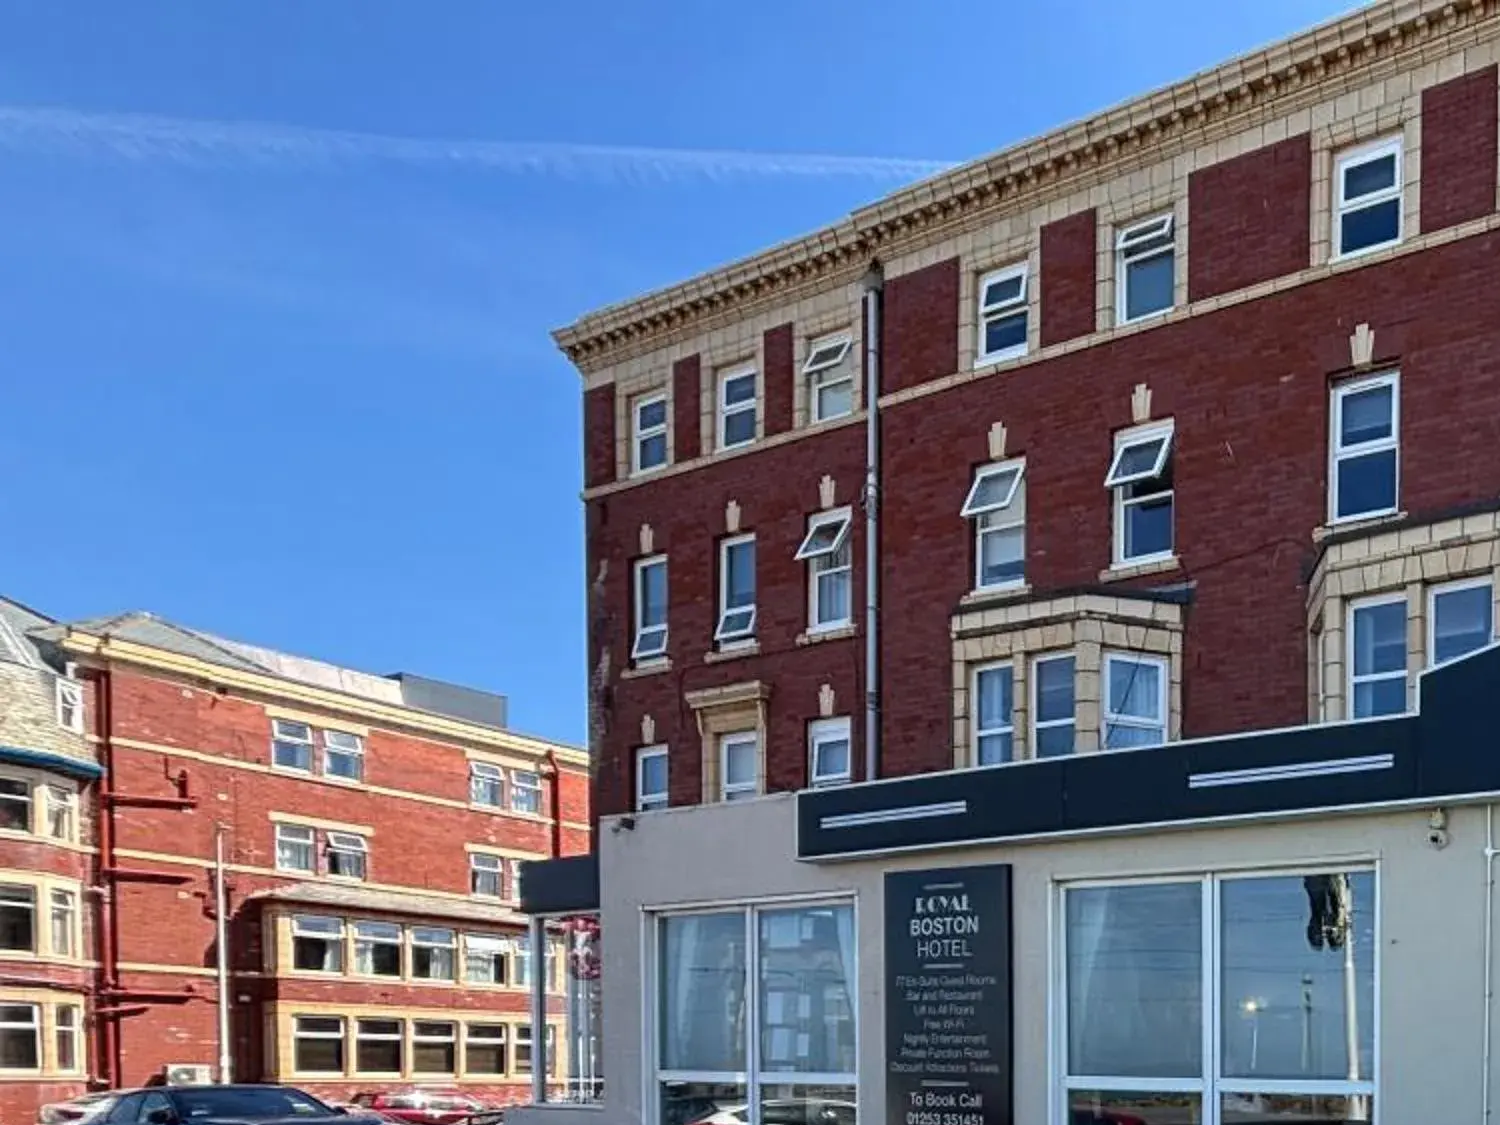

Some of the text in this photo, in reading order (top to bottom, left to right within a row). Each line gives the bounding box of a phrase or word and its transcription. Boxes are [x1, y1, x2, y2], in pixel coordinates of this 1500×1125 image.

[915, 894, 972, 914] ROYAL
[910, 915, 979, 936] BOSTON
[917, 939, 974, 957] HOTEL
[909, 1092, 983, 1108] To Book Call
